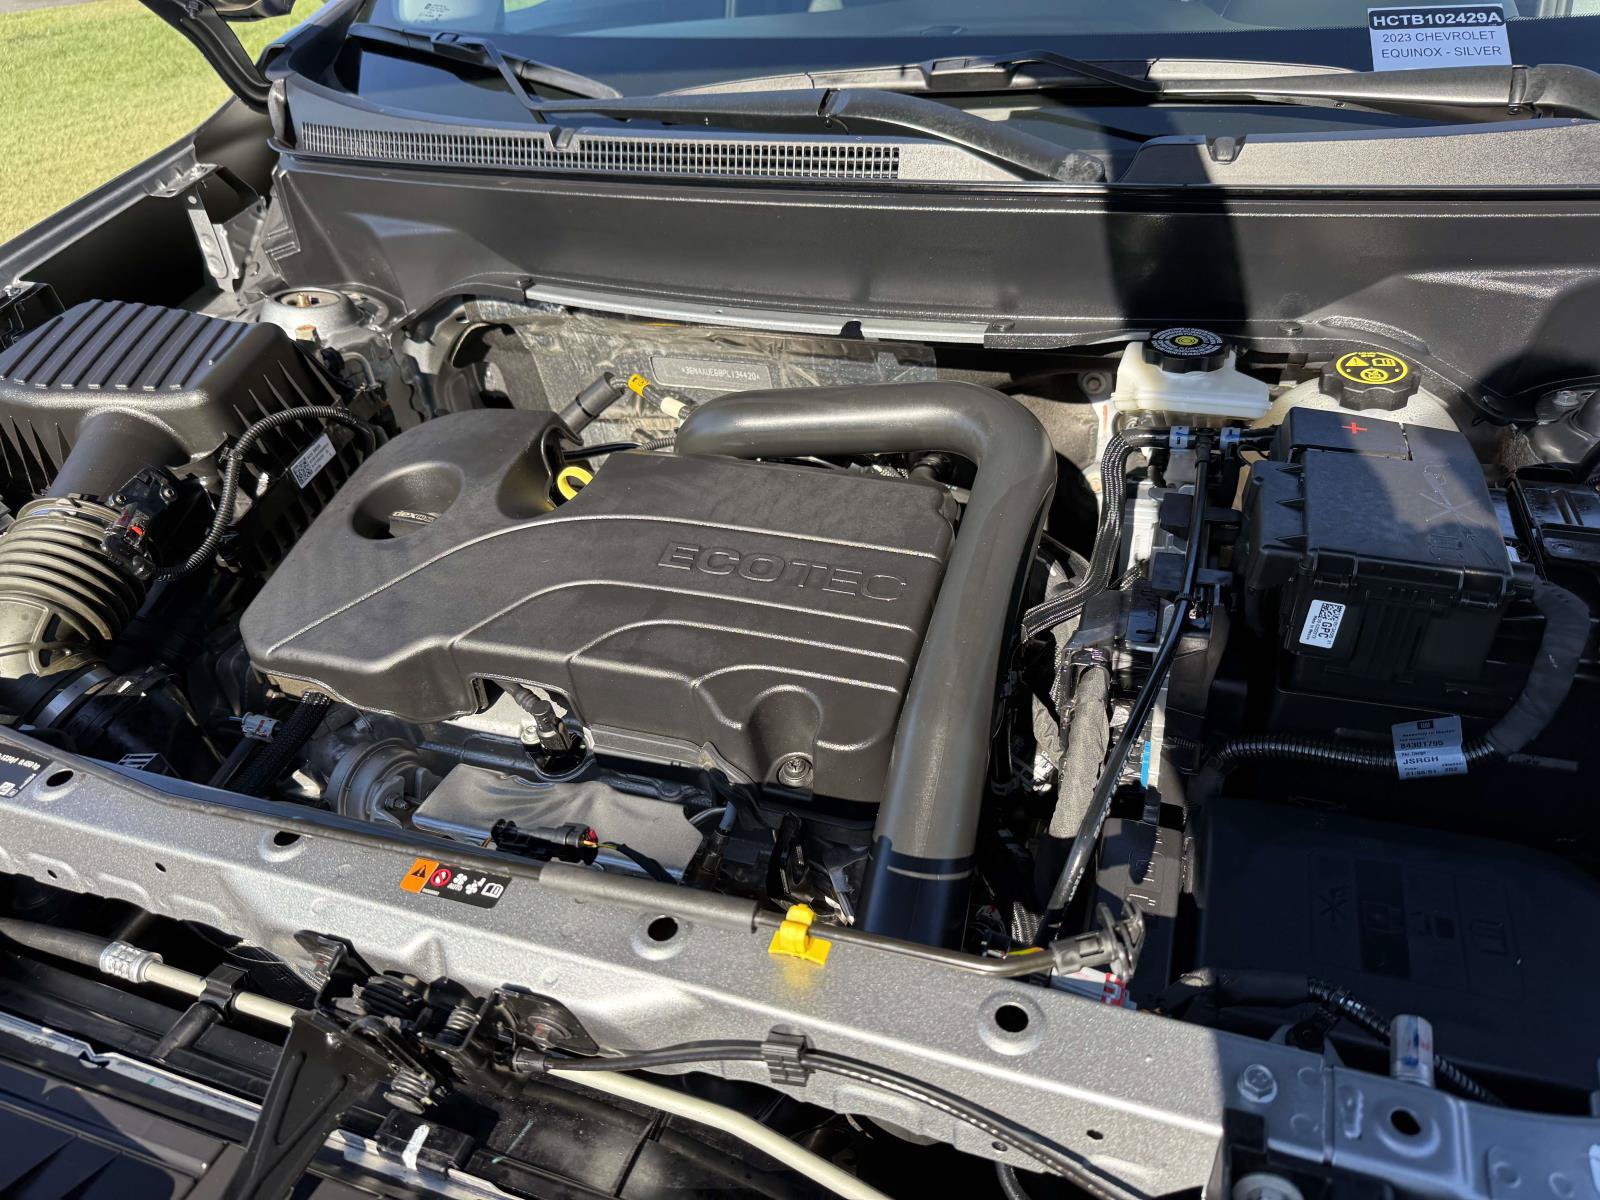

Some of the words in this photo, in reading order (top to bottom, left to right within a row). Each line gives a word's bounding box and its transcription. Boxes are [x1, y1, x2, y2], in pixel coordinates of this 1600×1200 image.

[1373, 12, 1502, 26] HCTB102429A
[1382, 32, 1412, 43] 2023
[1415, 30, 1496, 42] CHEVROLET
[1381, 47, 1443, 59] EQUINOX
[1454, 45, 1502, 57] SILVER
[658, 542, 906, 601] ECOTEC
[1318, 621, 1333, 639] GPC
